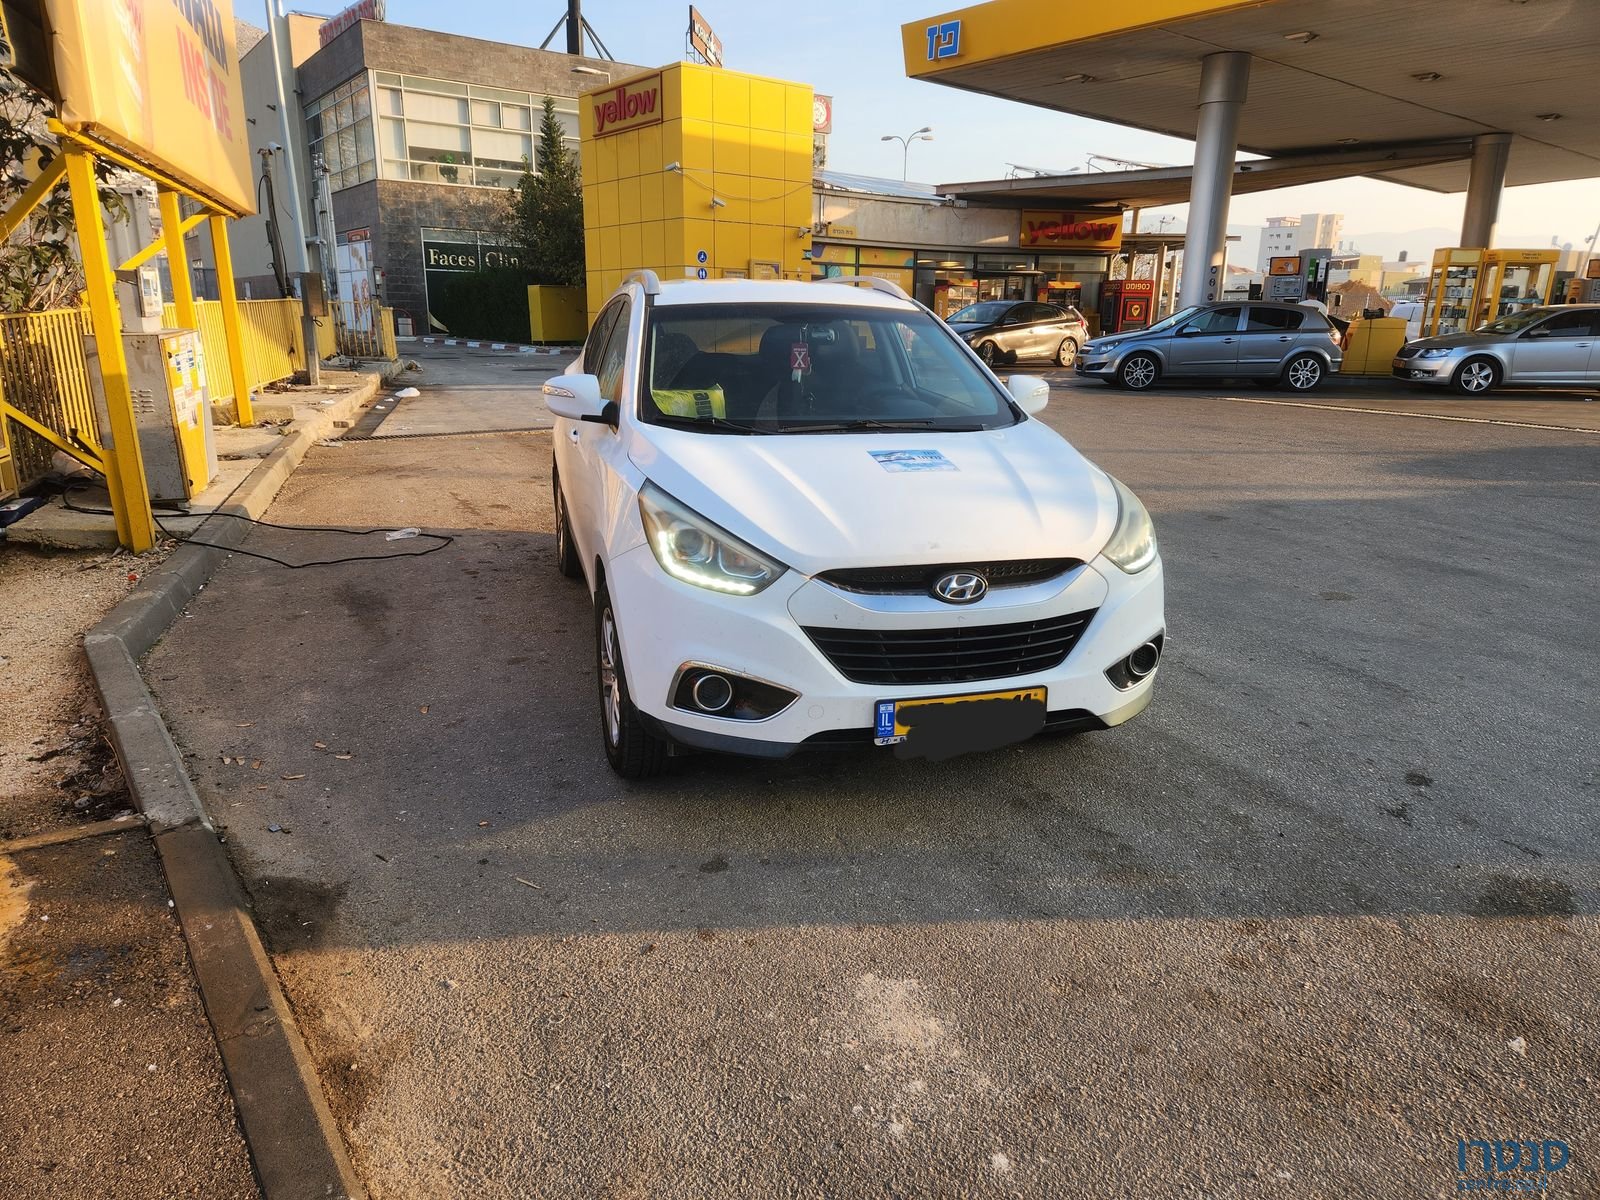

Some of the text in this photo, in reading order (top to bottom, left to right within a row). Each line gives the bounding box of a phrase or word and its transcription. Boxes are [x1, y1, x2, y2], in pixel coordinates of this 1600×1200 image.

[927, 20, 960, 61] פז
[594, 87, 657, 132] yellow
[1027, 213, 1118, 244] yellow
[428, 248, 476, 267] Faces
[793, 352, 806, 368] X
[881, 713, 892, 727] IL
